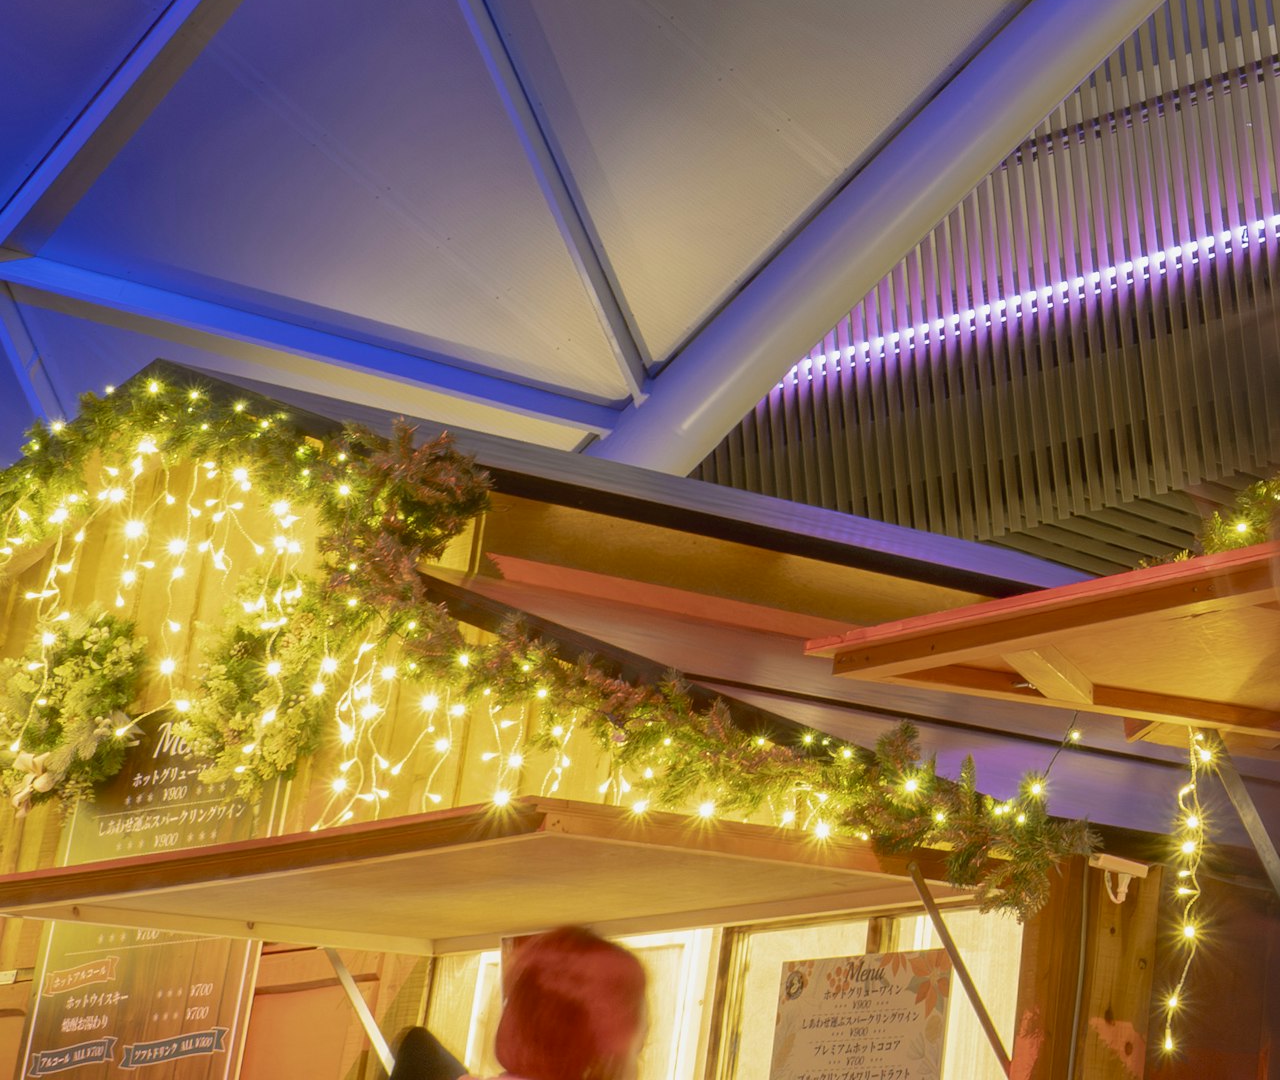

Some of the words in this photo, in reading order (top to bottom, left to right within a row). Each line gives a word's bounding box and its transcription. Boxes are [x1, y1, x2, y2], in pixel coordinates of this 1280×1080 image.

[163, 785, 188, 802] ¥900
[154, 833, 179, 849] ¥900
[844, 961, 886, 983] Menu
[66, 991, 129, 1010] ホットウイスキー
[189, 983, 213, 999] ¥700
[824, 984, 904, 1001] ホットグリューワイン
[186, 1006, 209, 1020] ¥700
[852, 1000, 872, 1010] ¥900
[814, 1040, 901, 1057] プレミアムホットココア
